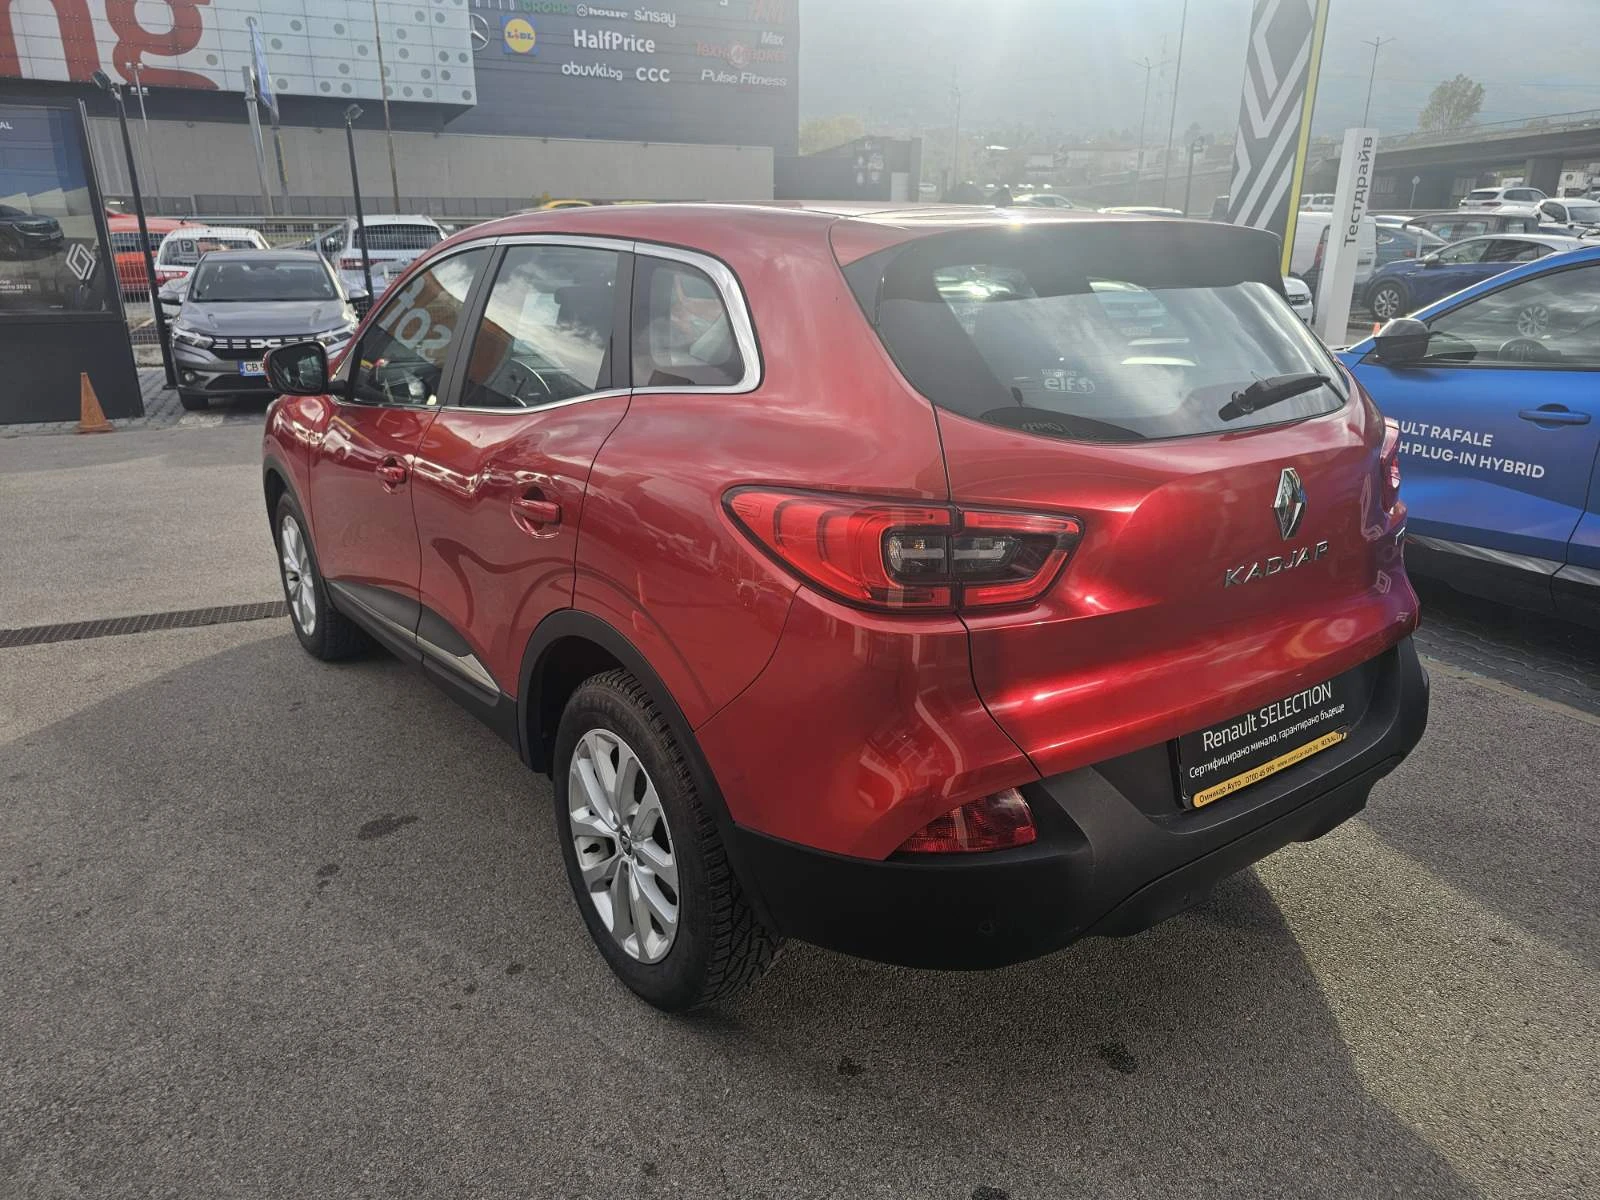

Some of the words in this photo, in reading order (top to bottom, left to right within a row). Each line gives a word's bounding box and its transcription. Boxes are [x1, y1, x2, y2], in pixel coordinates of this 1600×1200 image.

[634, 6, 676, 28] sinsay
[573, 29, 656, 53] HalfPrice
[562, 61, 623, 81] obuvki.bg
[636, 67, 671, 82] CCC
[701, 69, 737, 83] Pulse
[740, 72, 787, 87] Fitness
[1344, 136, 1373, 248] Тестдрайв
[1044, 377, 1075, 391] elf
[1400, 420, 1429, 436] ULT
[1430, 426, 1493, 447] RAFALE
[1398, 441, 1410, 454] H
[1413, 443, 1477, 467] PLUG-IN
[1479, 455, 1545, 479] HYBRID
[1224, 540, 1330, 588] KADJAR
[1202, 714, 1257, 751] Renault
[1259, 681, 1332, 728] SELECTION
[1189, 746, 1250, 778] Сертифицирано
[1279, 714, 1320, 740] гарантирано
